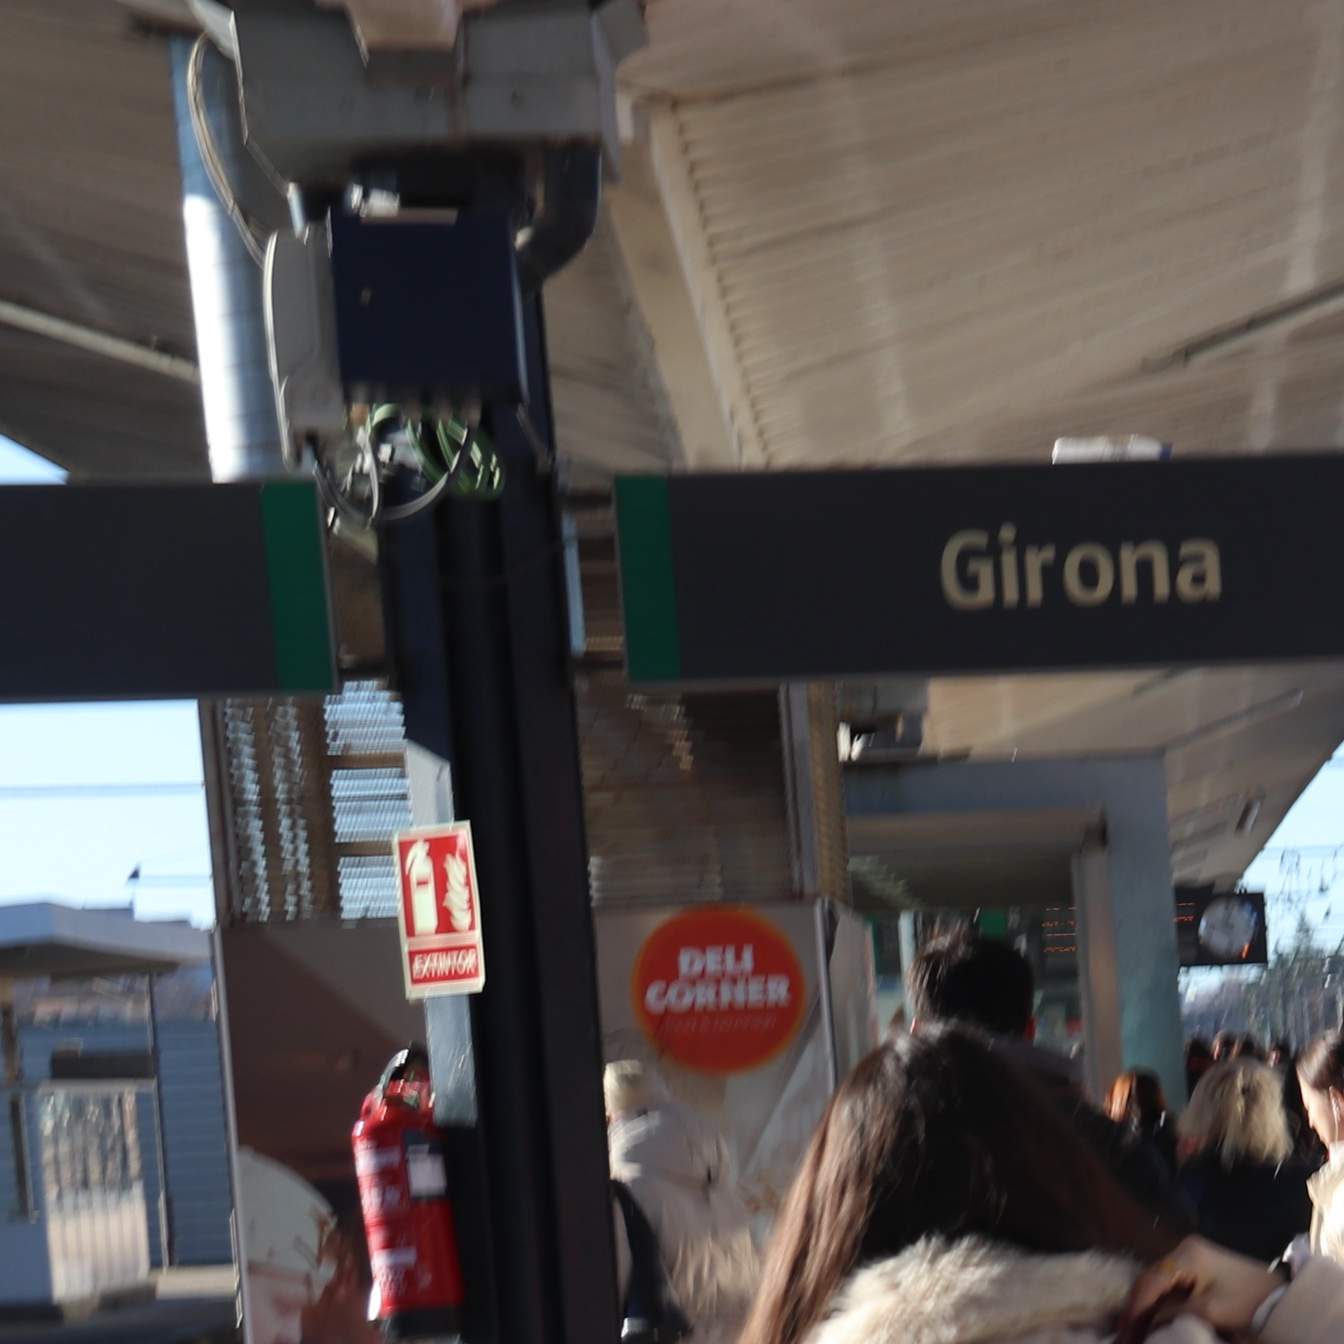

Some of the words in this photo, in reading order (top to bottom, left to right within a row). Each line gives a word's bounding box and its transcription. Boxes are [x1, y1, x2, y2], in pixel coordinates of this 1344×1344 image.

[940, 521, 1222, 612] Girona
[412, 948, 477, 980] EXTINTOR
[678, 943, 754, 977] DELI
[645, 975, 791, 1014] CORNER
